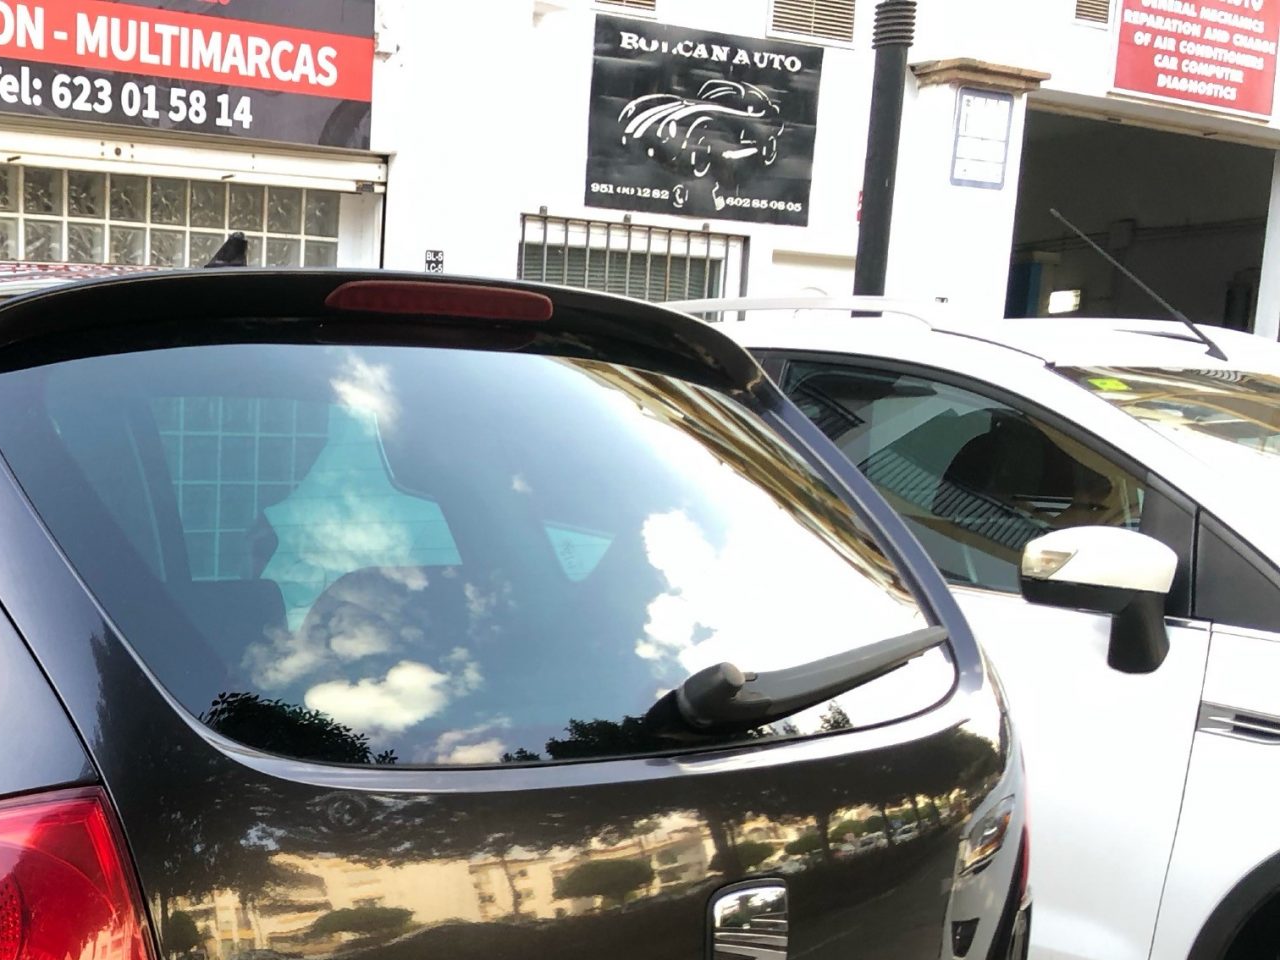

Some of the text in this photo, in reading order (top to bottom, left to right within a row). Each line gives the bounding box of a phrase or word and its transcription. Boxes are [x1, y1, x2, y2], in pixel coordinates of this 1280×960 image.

[1123, 9, 1276, 55] REPARATION AND CHARGE
[1200, 6, 1265, 33] MECHANICS
[76, 13, 338, 87] MULTIMARCAS
[732, 49, 802, 72] AUTO
[1133, 31, 1264, 70] OF AIR CONDITIONERS
[1153, 53, 1244, 83] CAR COMPUTER
[51, 73, 112, 114] 623
[120, 82, 160, 119] 01
[168, 87, 207, 124] 58
[215, 94, 253, 129] 14
[1156, 73, 1237, 100] DIAGNOSTICS
